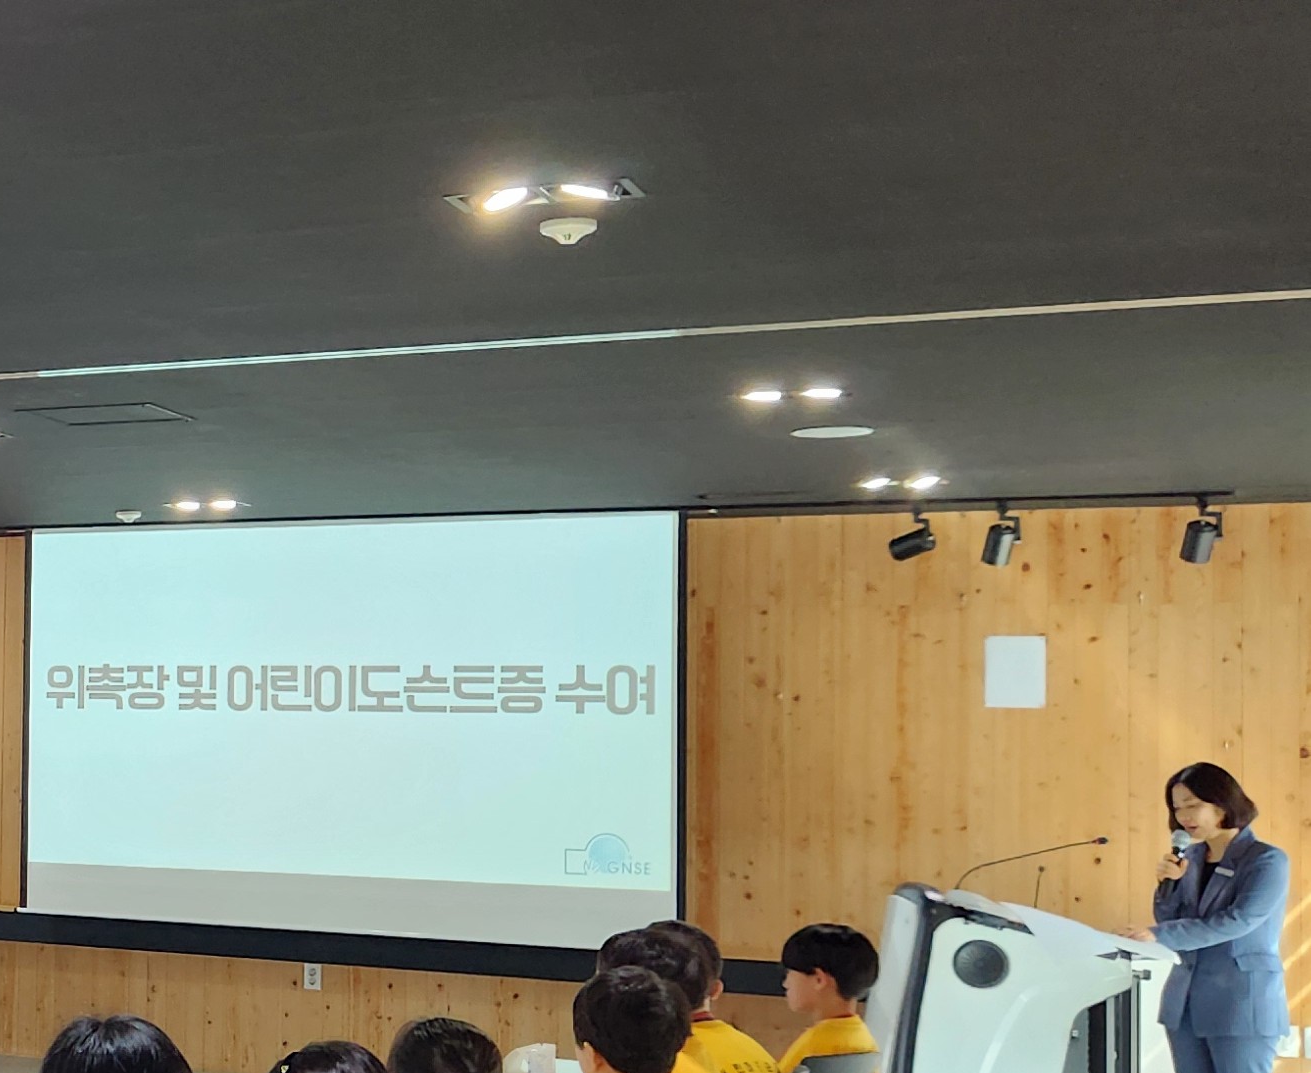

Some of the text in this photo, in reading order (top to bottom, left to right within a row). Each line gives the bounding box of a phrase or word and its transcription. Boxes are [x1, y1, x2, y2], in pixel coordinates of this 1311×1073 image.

[45, 663, 656, 716] 위촉장 및 어린이도슨트증 수여
[607, 861, 651, 876] GNSE
